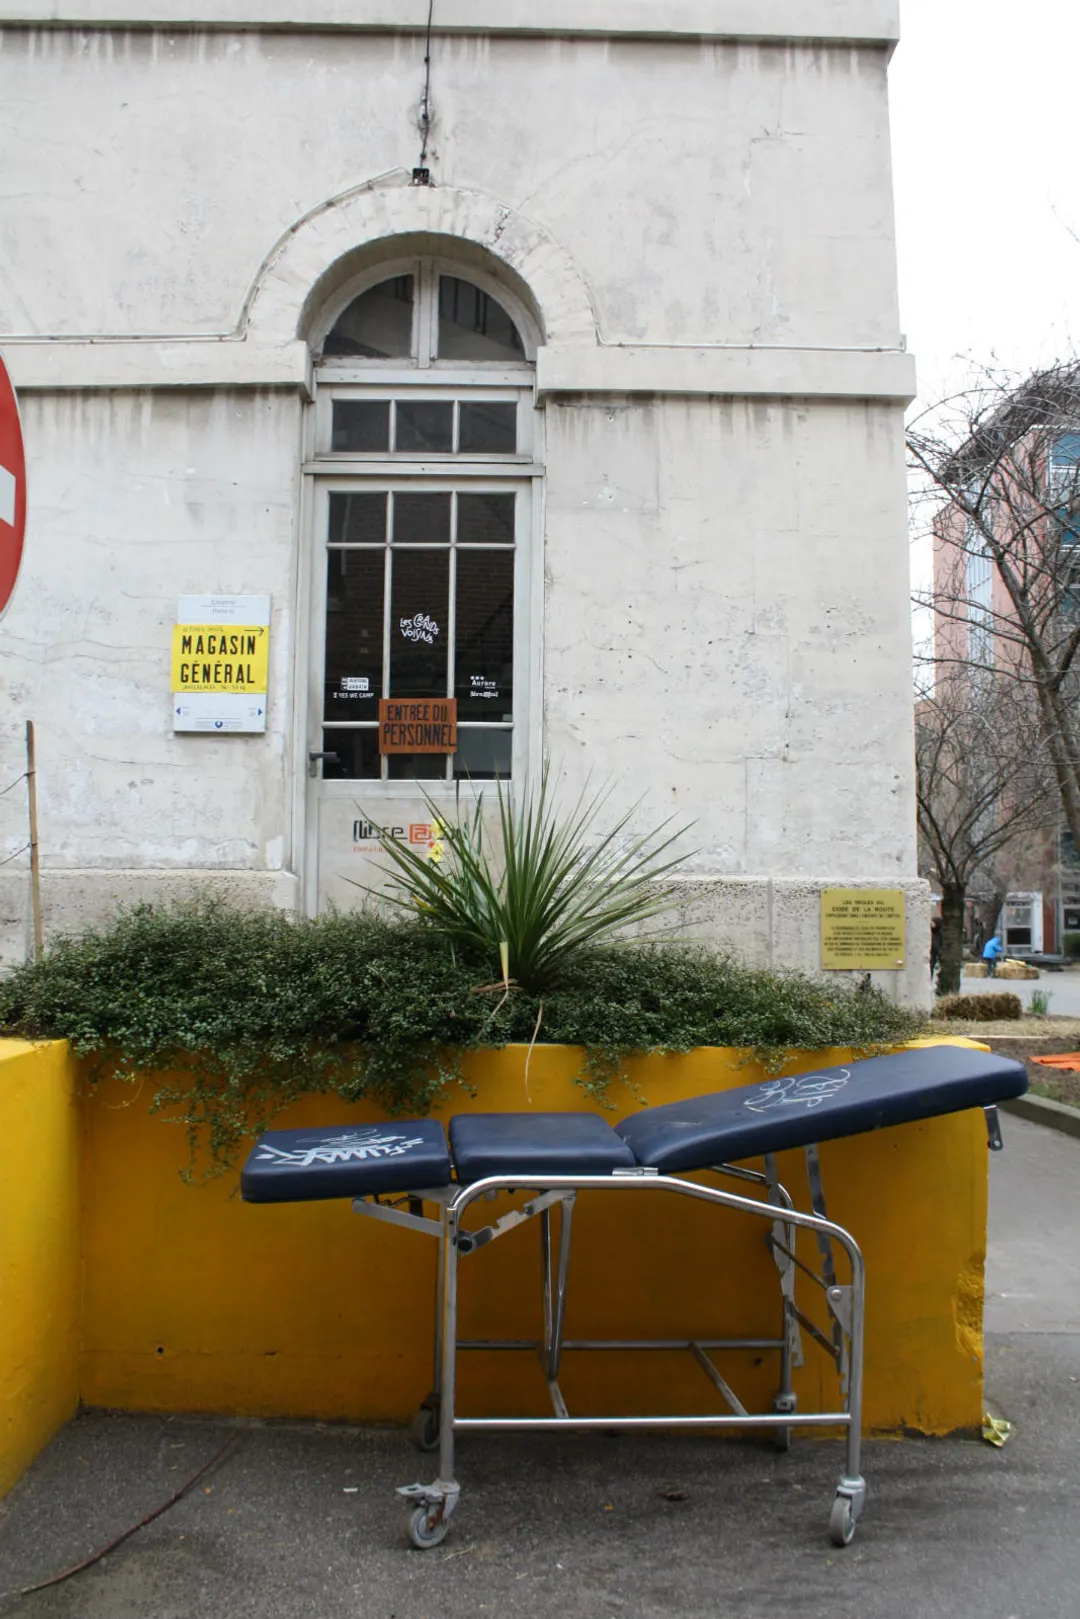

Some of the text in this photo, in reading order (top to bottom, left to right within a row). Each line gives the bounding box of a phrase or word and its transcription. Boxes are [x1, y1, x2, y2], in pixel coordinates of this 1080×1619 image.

[181, 635, 256, 655] MAGASIN
[180, 660, 256, 684] GÉNÉRAL
[432, 704, 448, 721] DU
[383, 723, 457, 747] PERSONNEL
